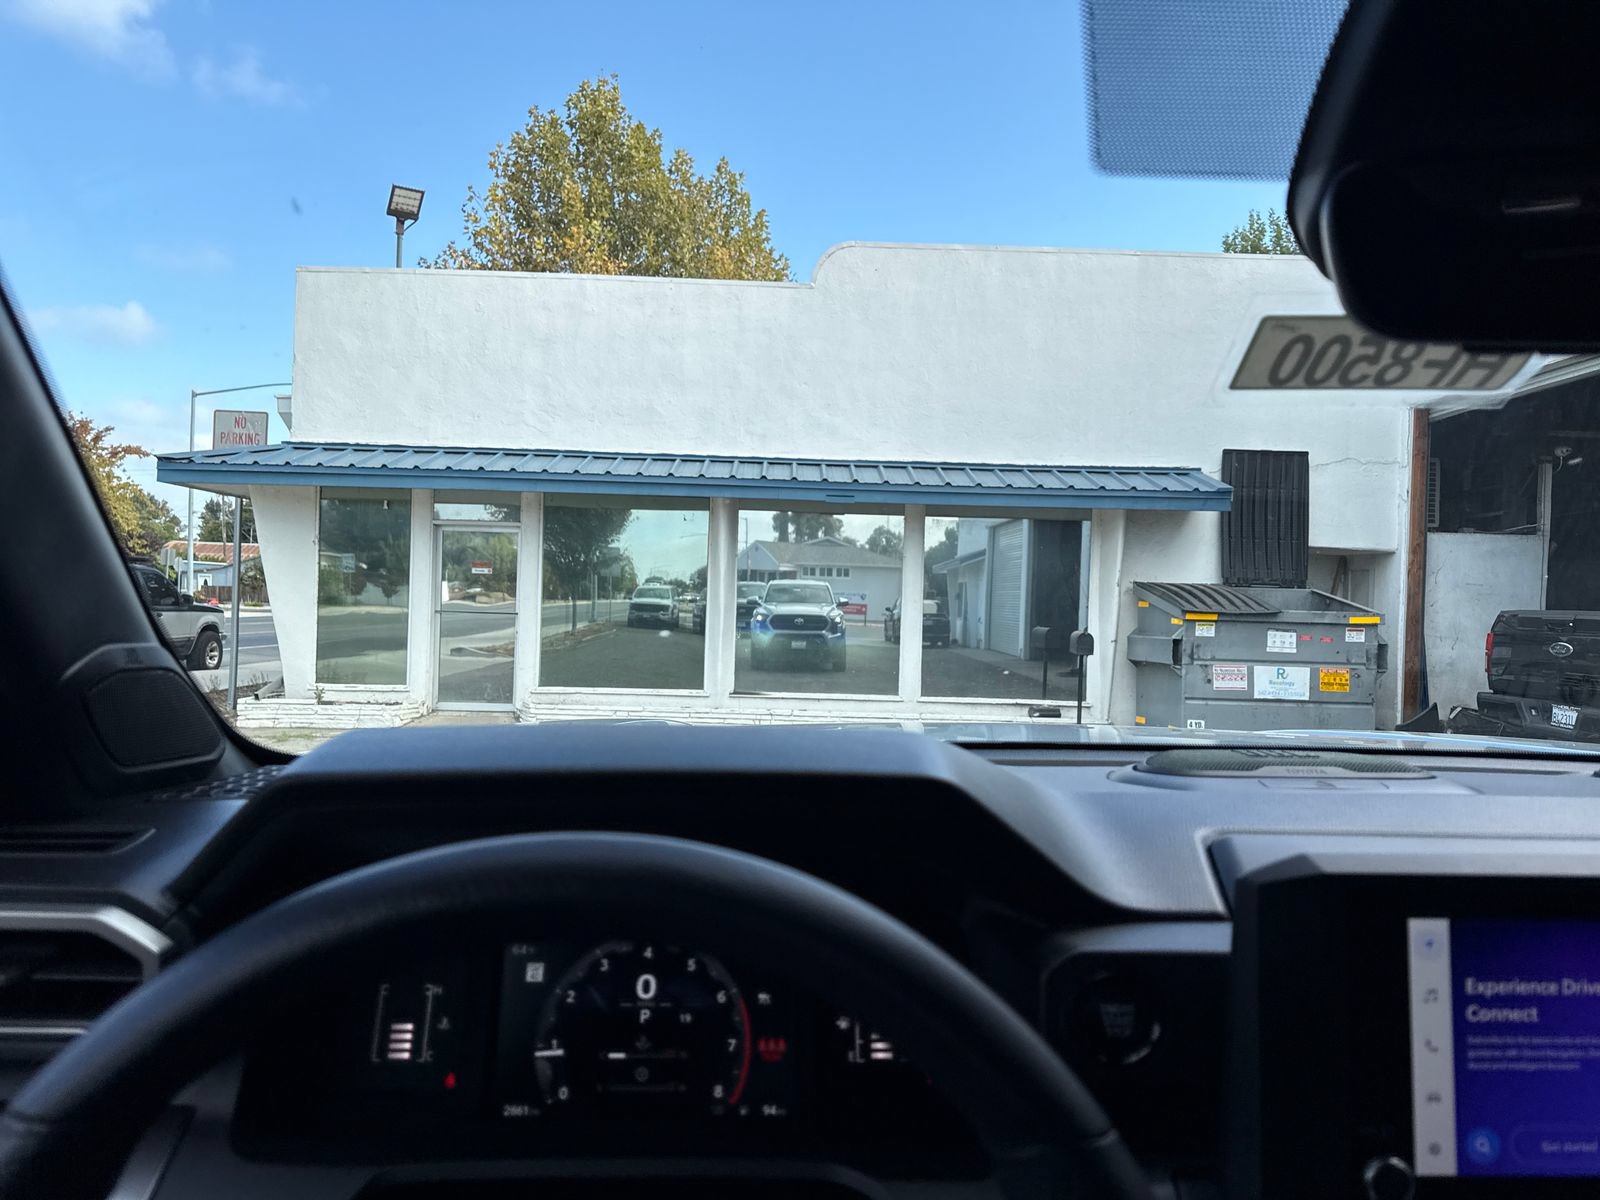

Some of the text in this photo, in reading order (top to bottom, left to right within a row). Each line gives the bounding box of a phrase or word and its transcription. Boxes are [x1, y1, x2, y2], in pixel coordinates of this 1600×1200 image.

[234, 416, 247, 429] NO
[220, 432, 260, 446] PARKING
[600, 958, 609, 971] 3
[687, 958, 697, 971] 5
[635, 973, 657, 1000] 0
[1464, 977, 1558, 998] Experience
[566, 990, 575, 1004] 2
[717, 990, 727, 1004] 6
[639, 1009, 651, 1024] P
[1465, 1004, 1538, 1023] Connect
[728, 1039, 737, 1051] 7
